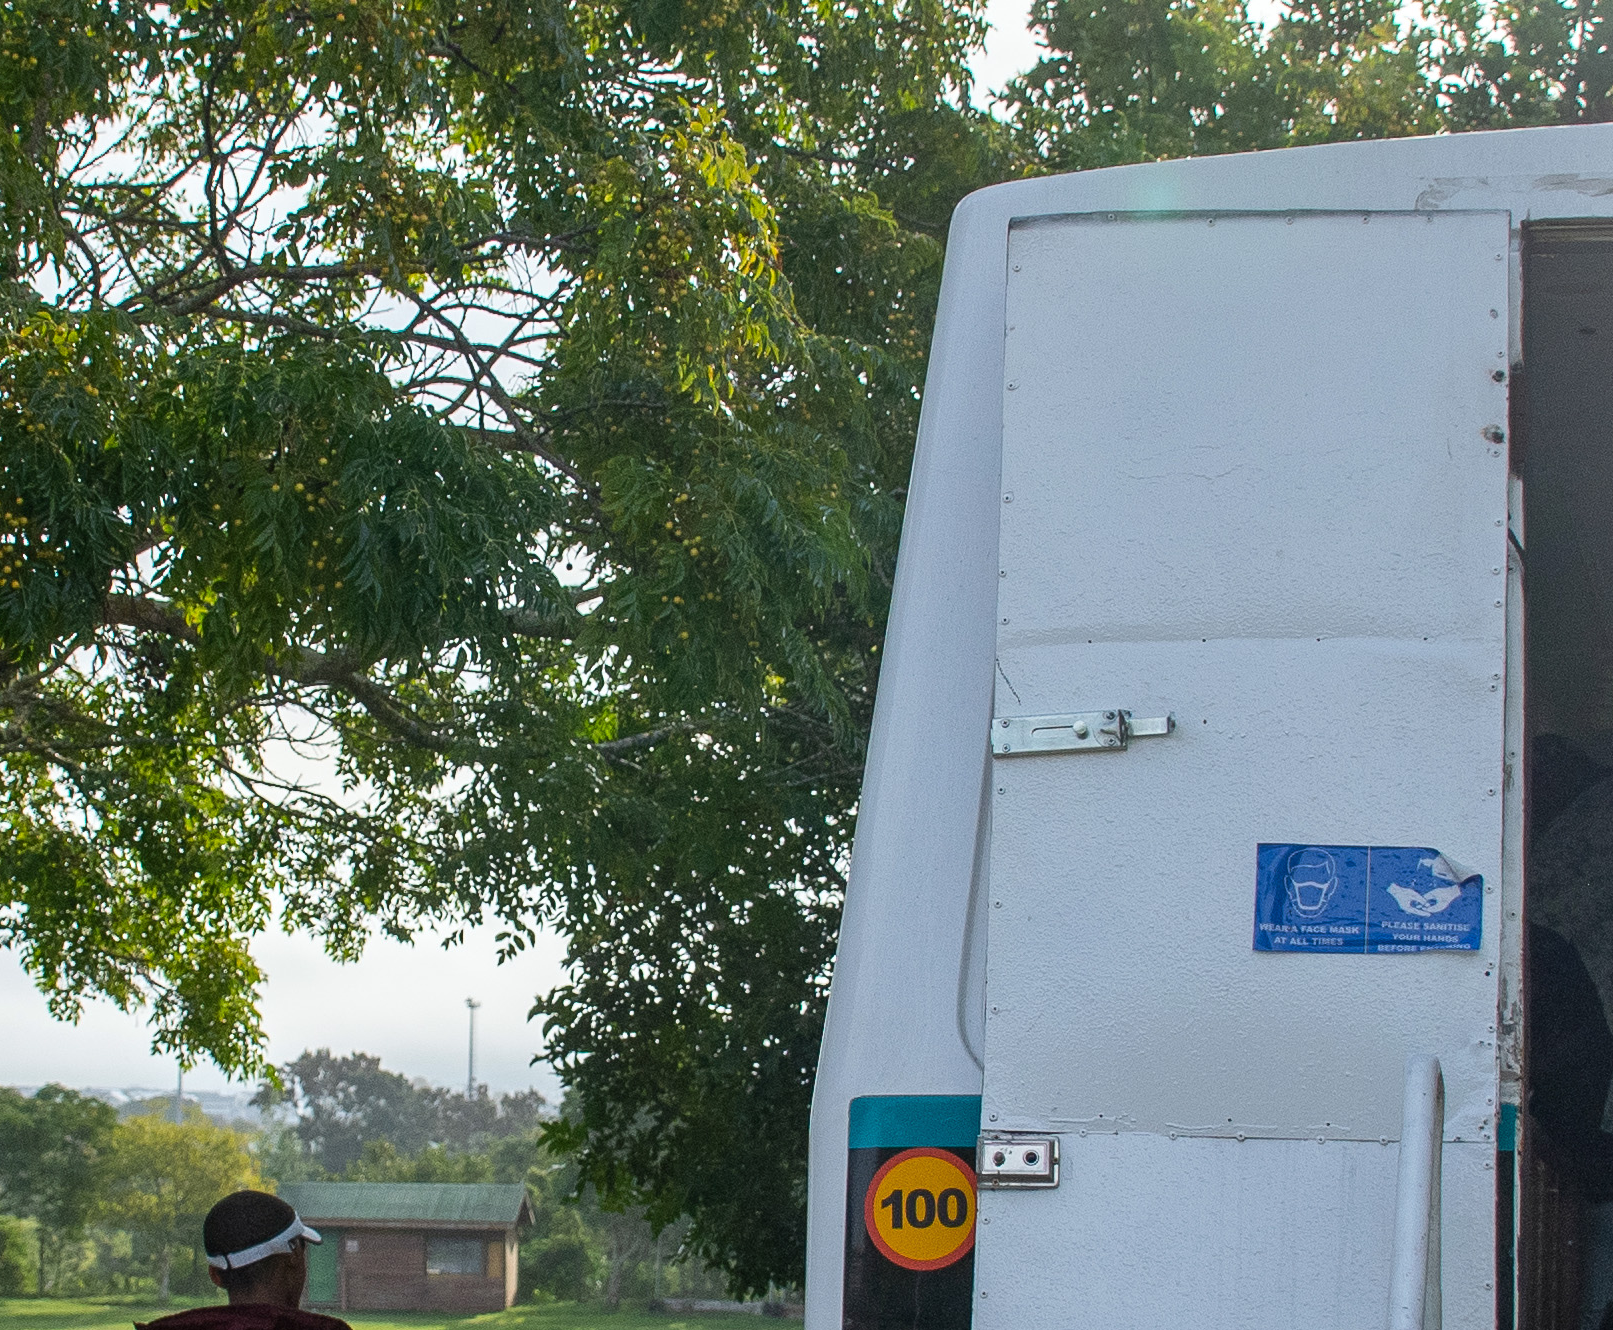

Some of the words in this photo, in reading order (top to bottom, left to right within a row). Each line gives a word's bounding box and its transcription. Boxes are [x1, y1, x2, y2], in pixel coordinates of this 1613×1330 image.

[1259, 923, 1288, 932] WEAR
[1329, 926, 1359, 934] MASK
[1381, 921, 1420, 930] PLEASE
[1423, 923, 1470, 932] SANITISE
[1273, 936, 1287, 944] AT
[1289, 937, 1308, 945] ALL
[1312, 937, 1343, 946] TIMES
[1392, 933, 1420, 941] YOUR
[1423, 935, 1459, 943] HANDS
[1377, 944, 1417, 952] BEFORE
[881, 1187, 968, 1230] 100
